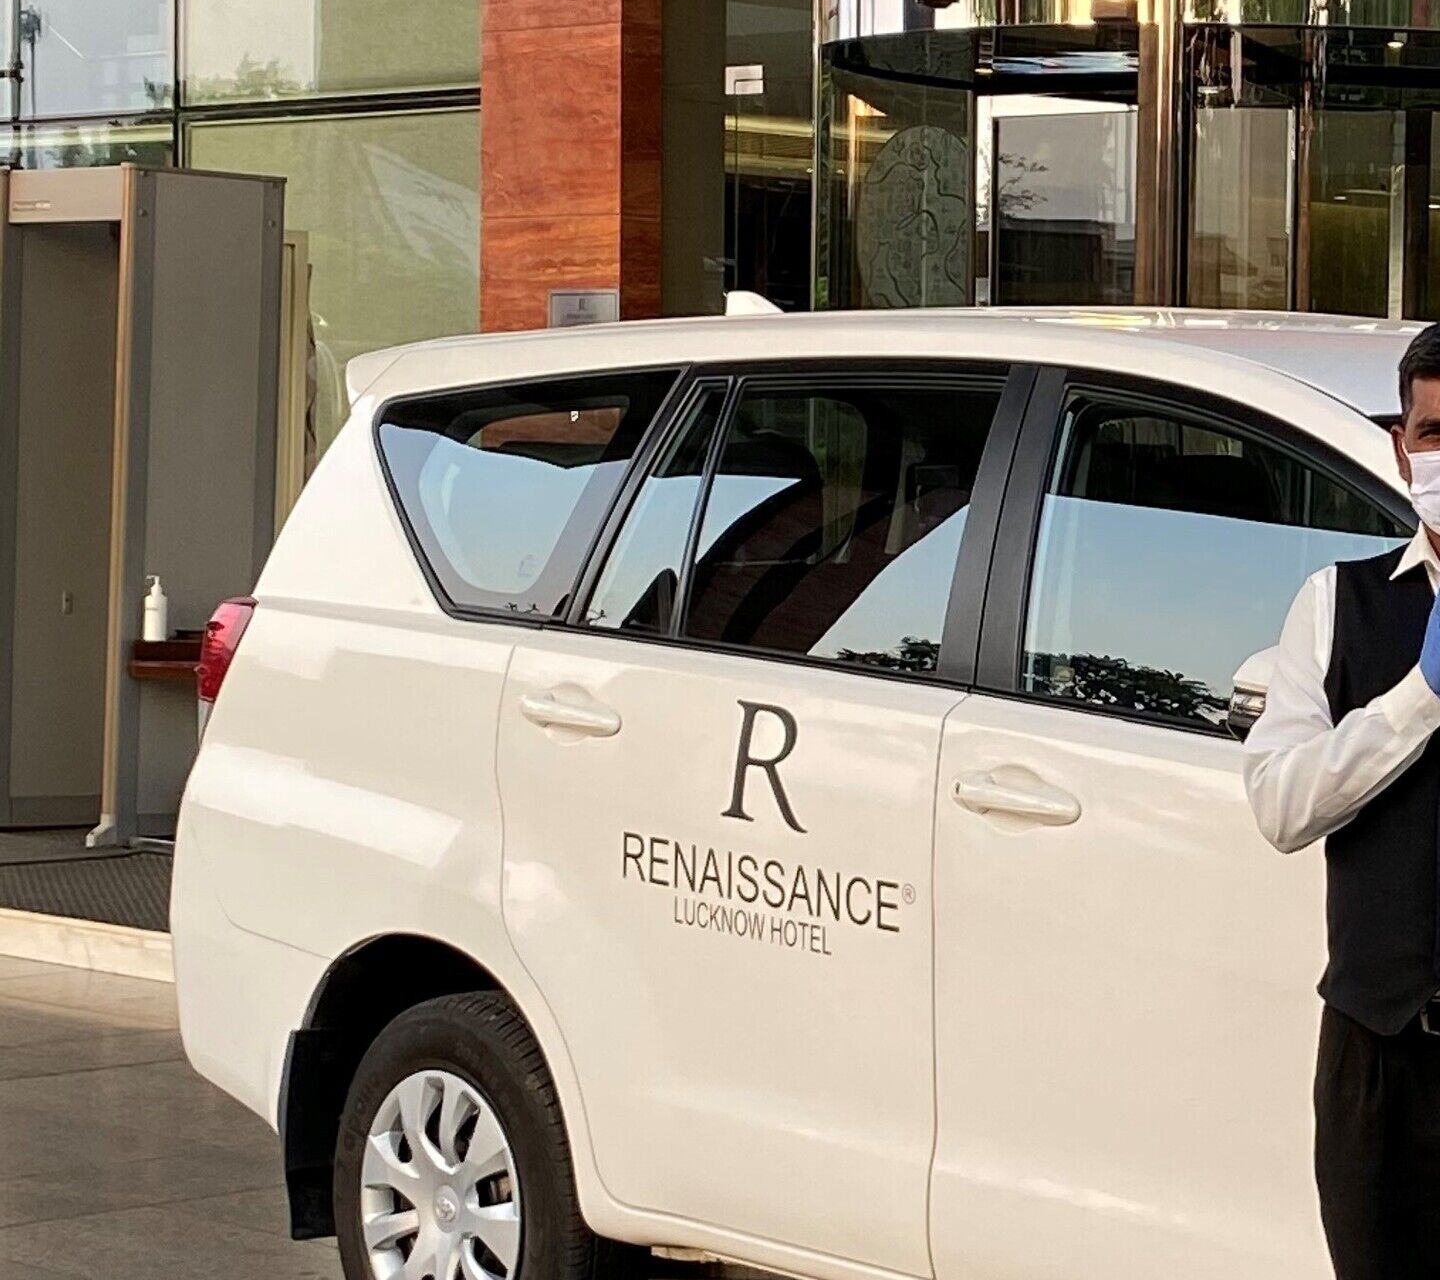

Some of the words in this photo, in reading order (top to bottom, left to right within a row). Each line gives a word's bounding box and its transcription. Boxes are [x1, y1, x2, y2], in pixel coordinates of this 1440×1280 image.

[720, 698, 808, 834] R
[674, 896, 766, 942] LUCKNOW
[771, 916, 833, 956] HOTEL
